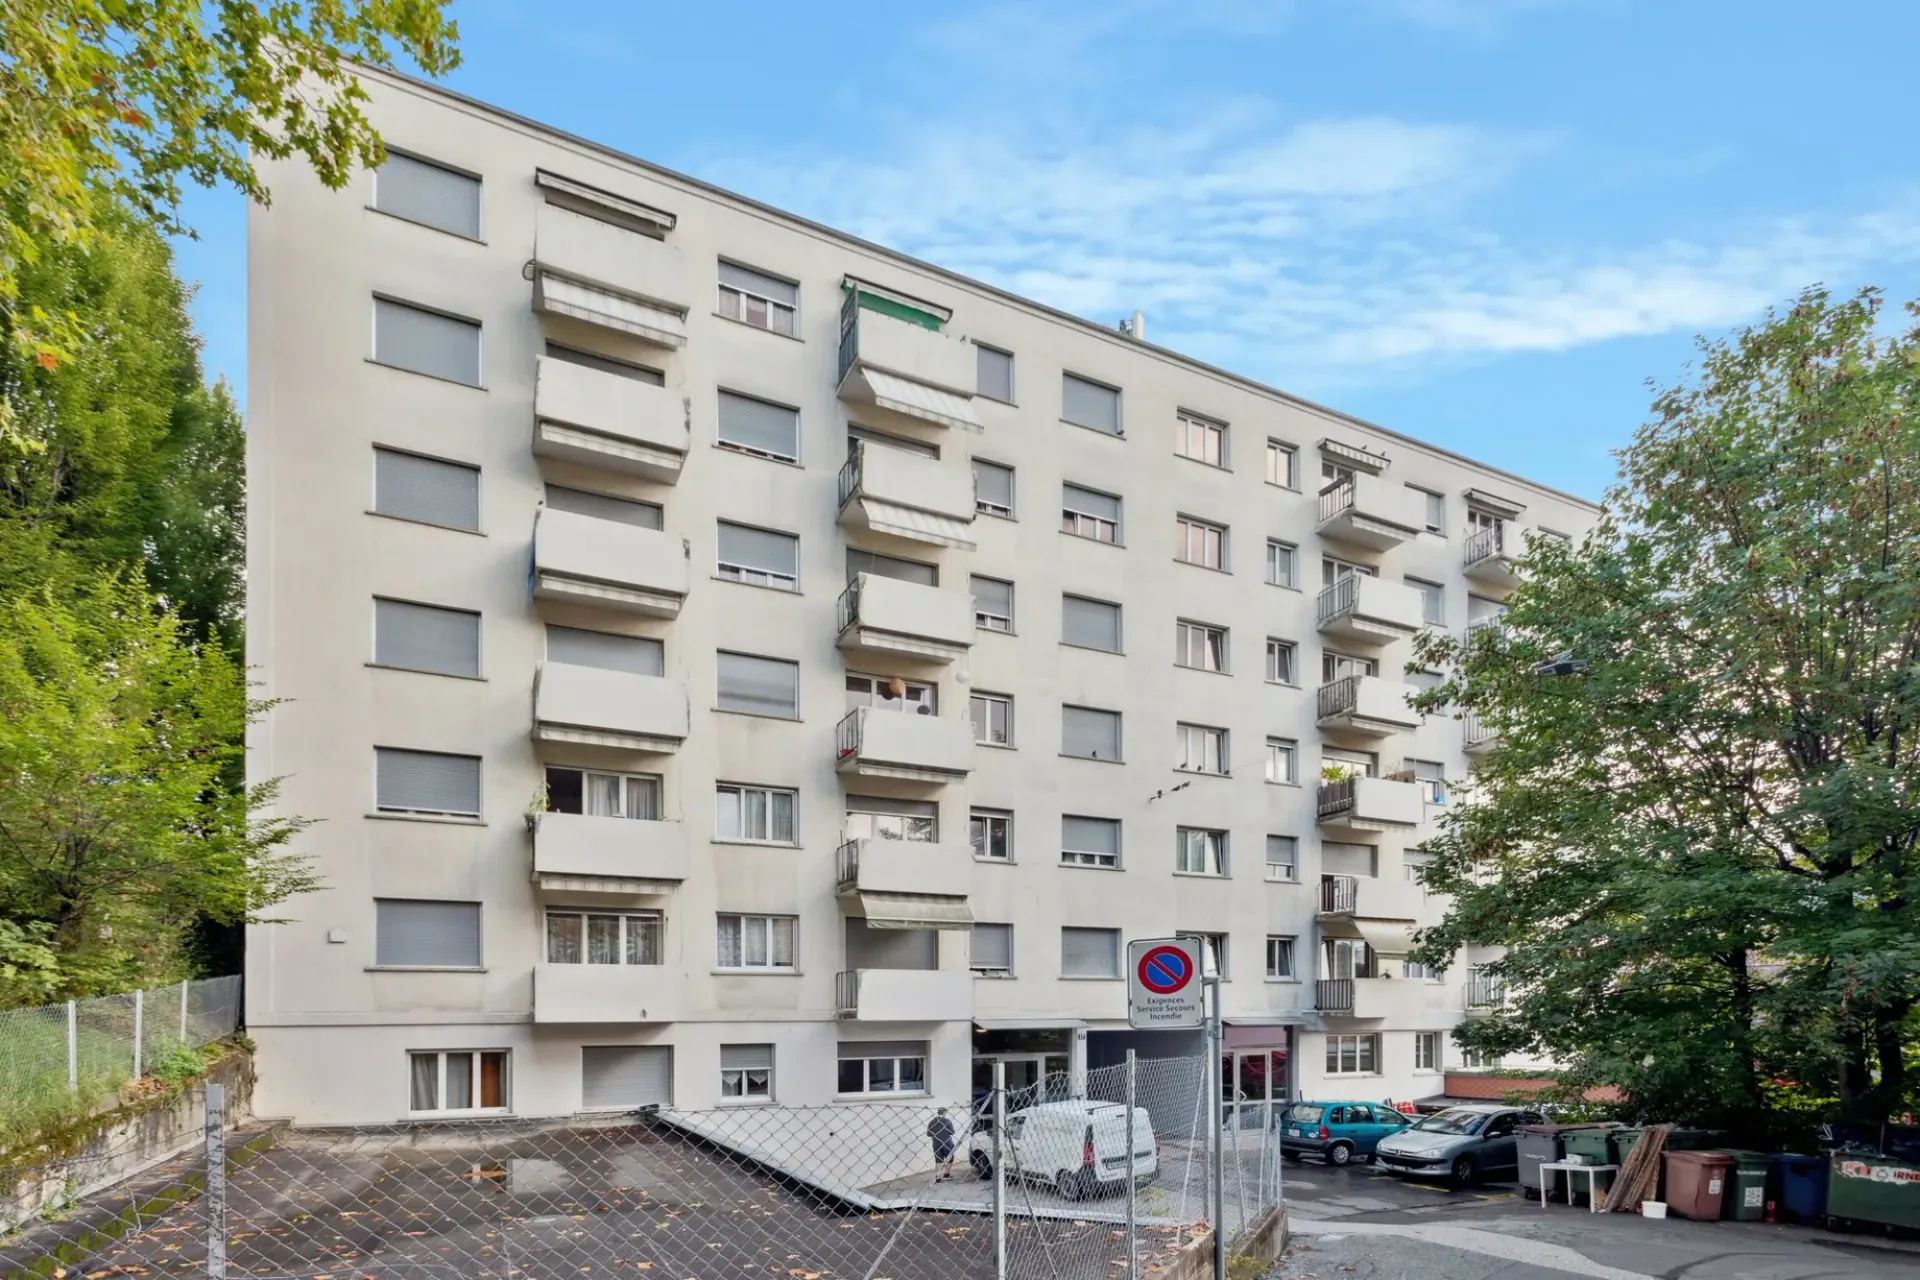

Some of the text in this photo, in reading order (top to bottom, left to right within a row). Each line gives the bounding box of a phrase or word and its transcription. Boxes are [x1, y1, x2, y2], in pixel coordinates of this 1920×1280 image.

[1147, 997, 1185, 1006] Exigences
[1136, 1004, 1196, 1013] Service Secours
[1150, 1012, 1182, 1021] Incendie
